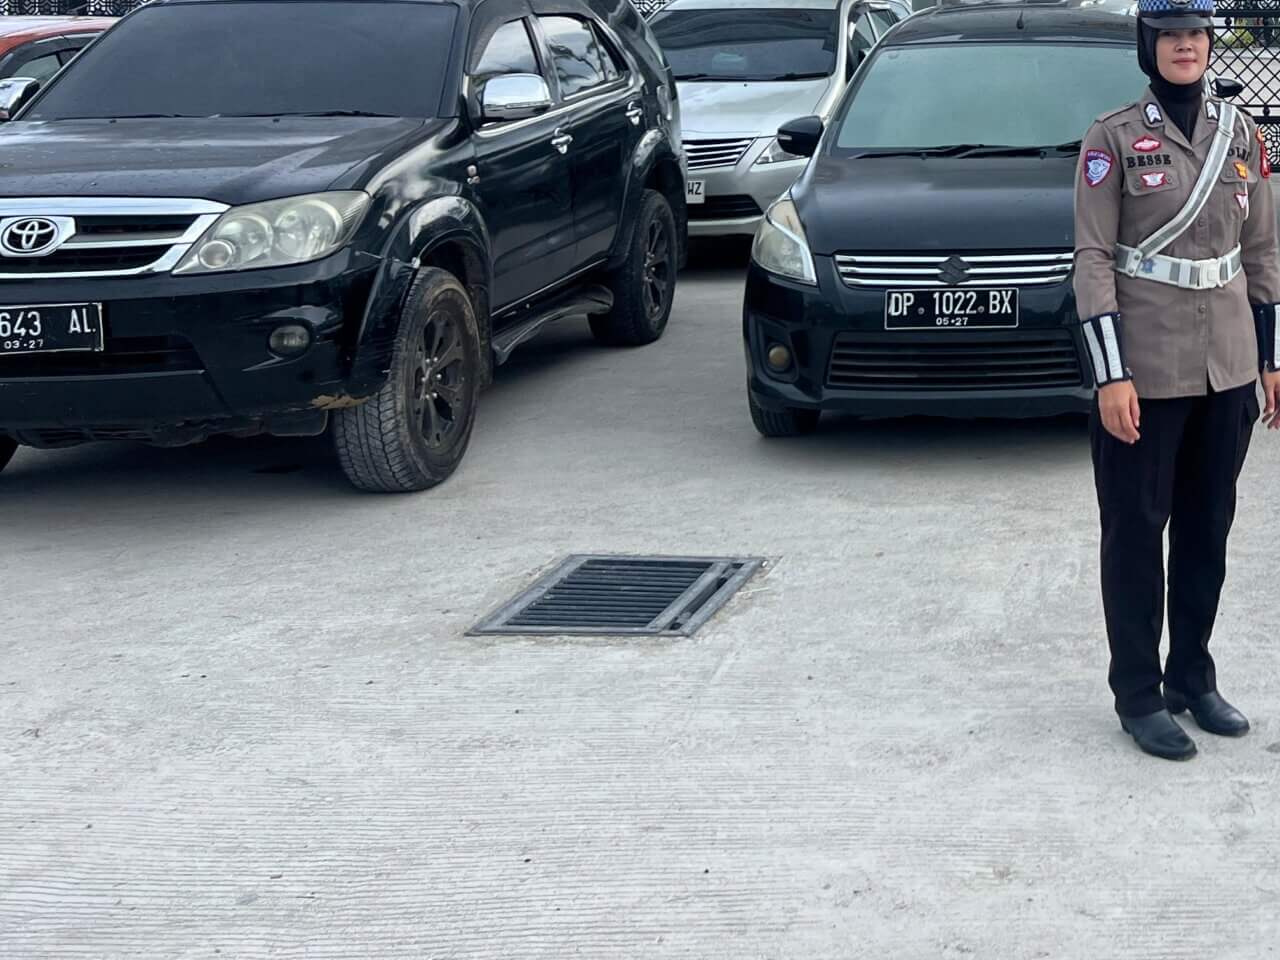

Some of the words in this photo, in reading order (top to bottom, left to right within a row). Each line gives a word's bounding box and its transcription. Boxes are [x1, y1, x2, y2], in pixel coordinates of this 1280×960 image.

[888, 292, 914, 316] DP
[933, 291, 977, 315] 1022
[989, 290, 1013, 314] BX
